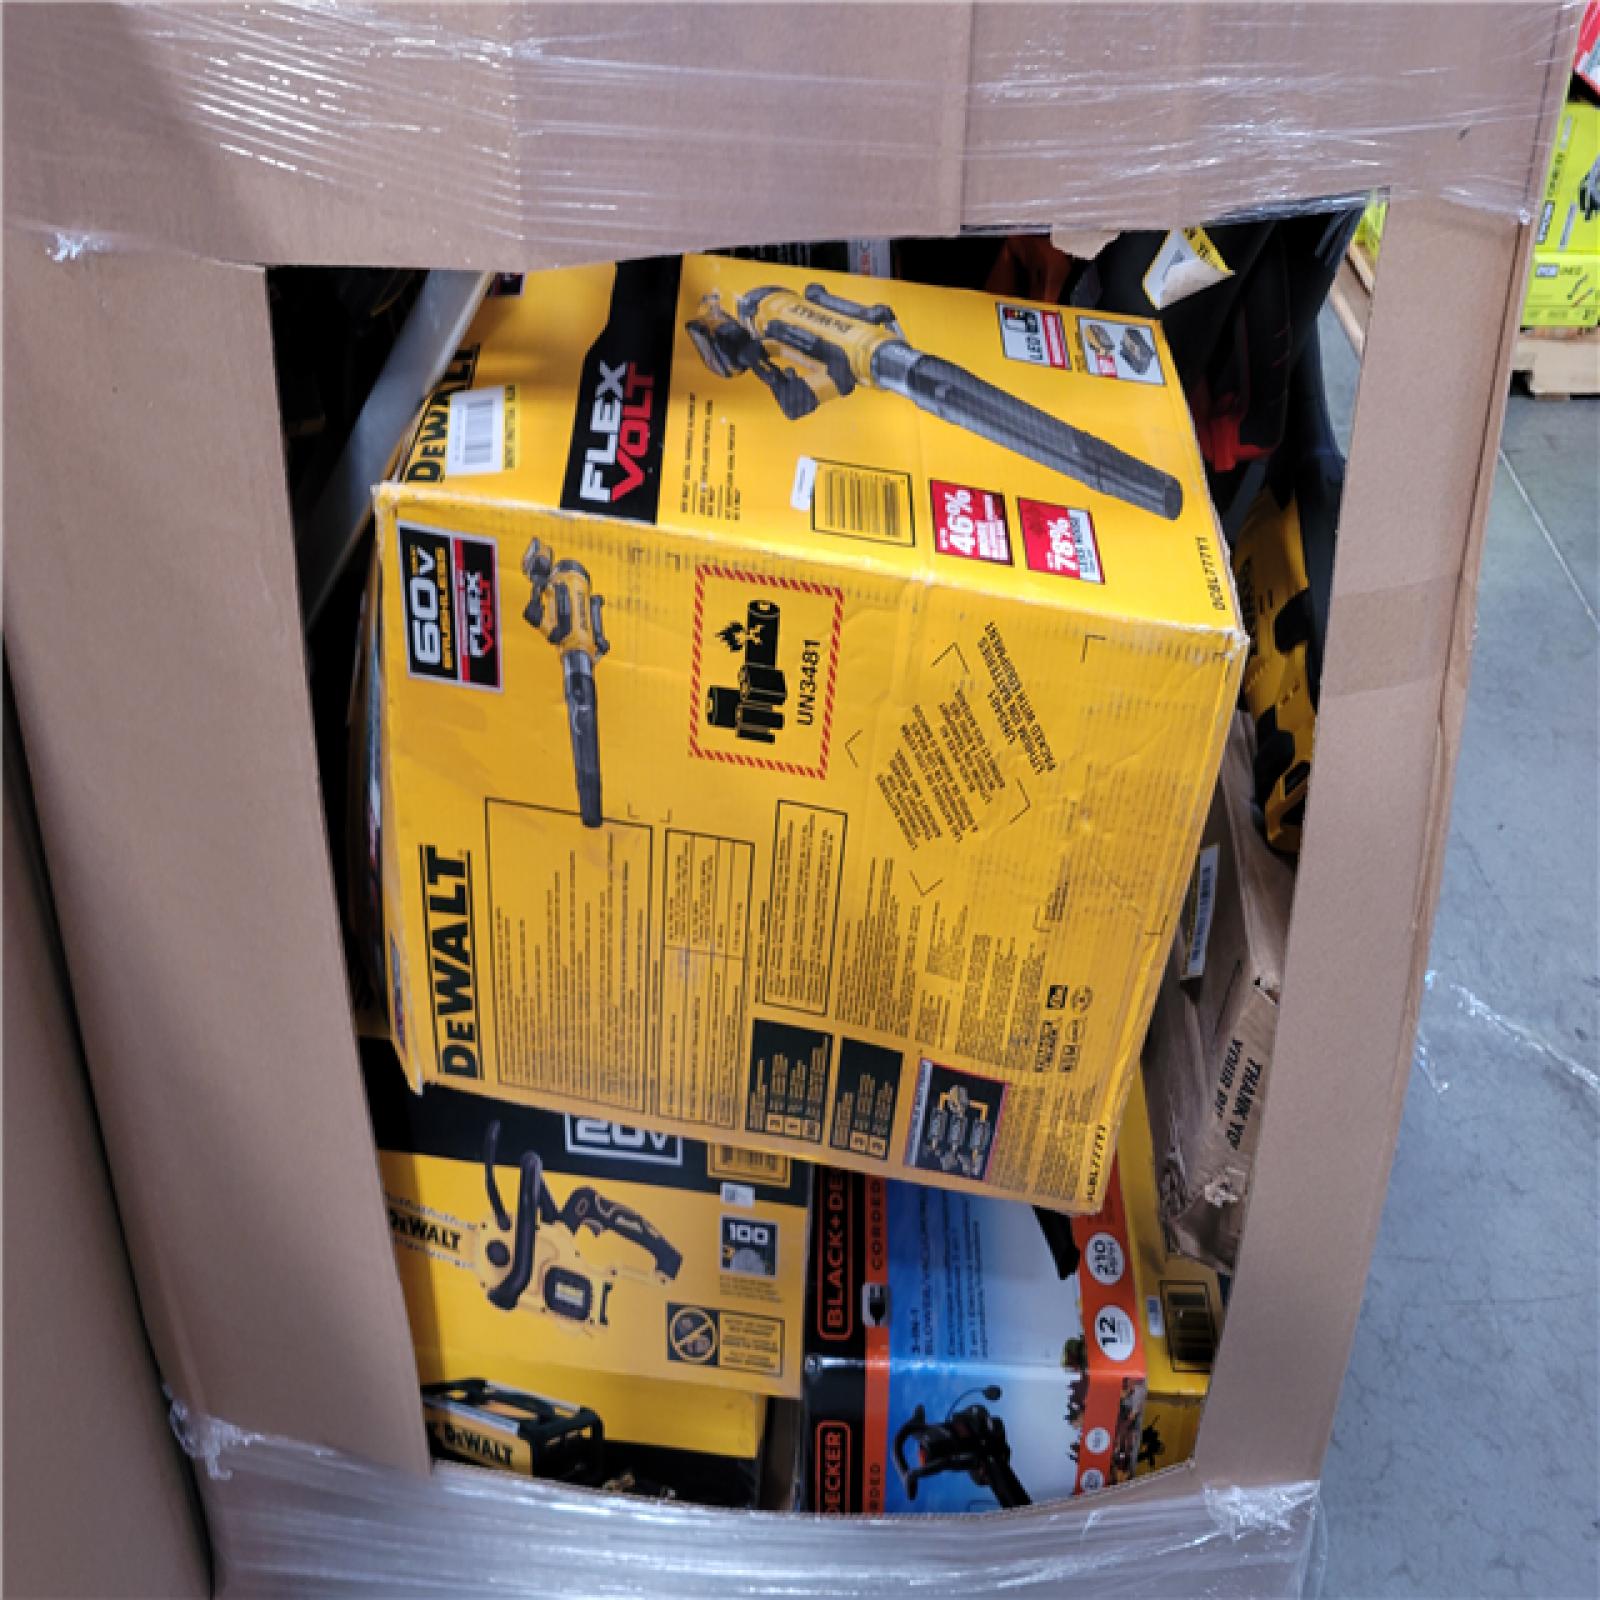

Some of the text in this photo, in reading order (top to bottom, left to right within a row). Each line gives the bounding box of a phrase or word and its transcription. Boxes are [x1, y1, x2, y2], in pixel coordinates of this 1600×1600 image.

[580, 360, 627, 503] FLEX
[611, 362, 654, 502] VOLT
[945, 489, 975, 555] 46%
[410, 545, 440, 664] 60V
[795, 640, 821, 724] UN3481
[427, 844, 477, 1078] DEWALT
[729, 1222, 769, 1246] 100
[871, 1179, 884, 1271] CORDED
[1095, 1239, 1107, 1276] 210
[1099, 1315, 1117, 1347] 12
[870, 1462, 881, 1513] RDED
